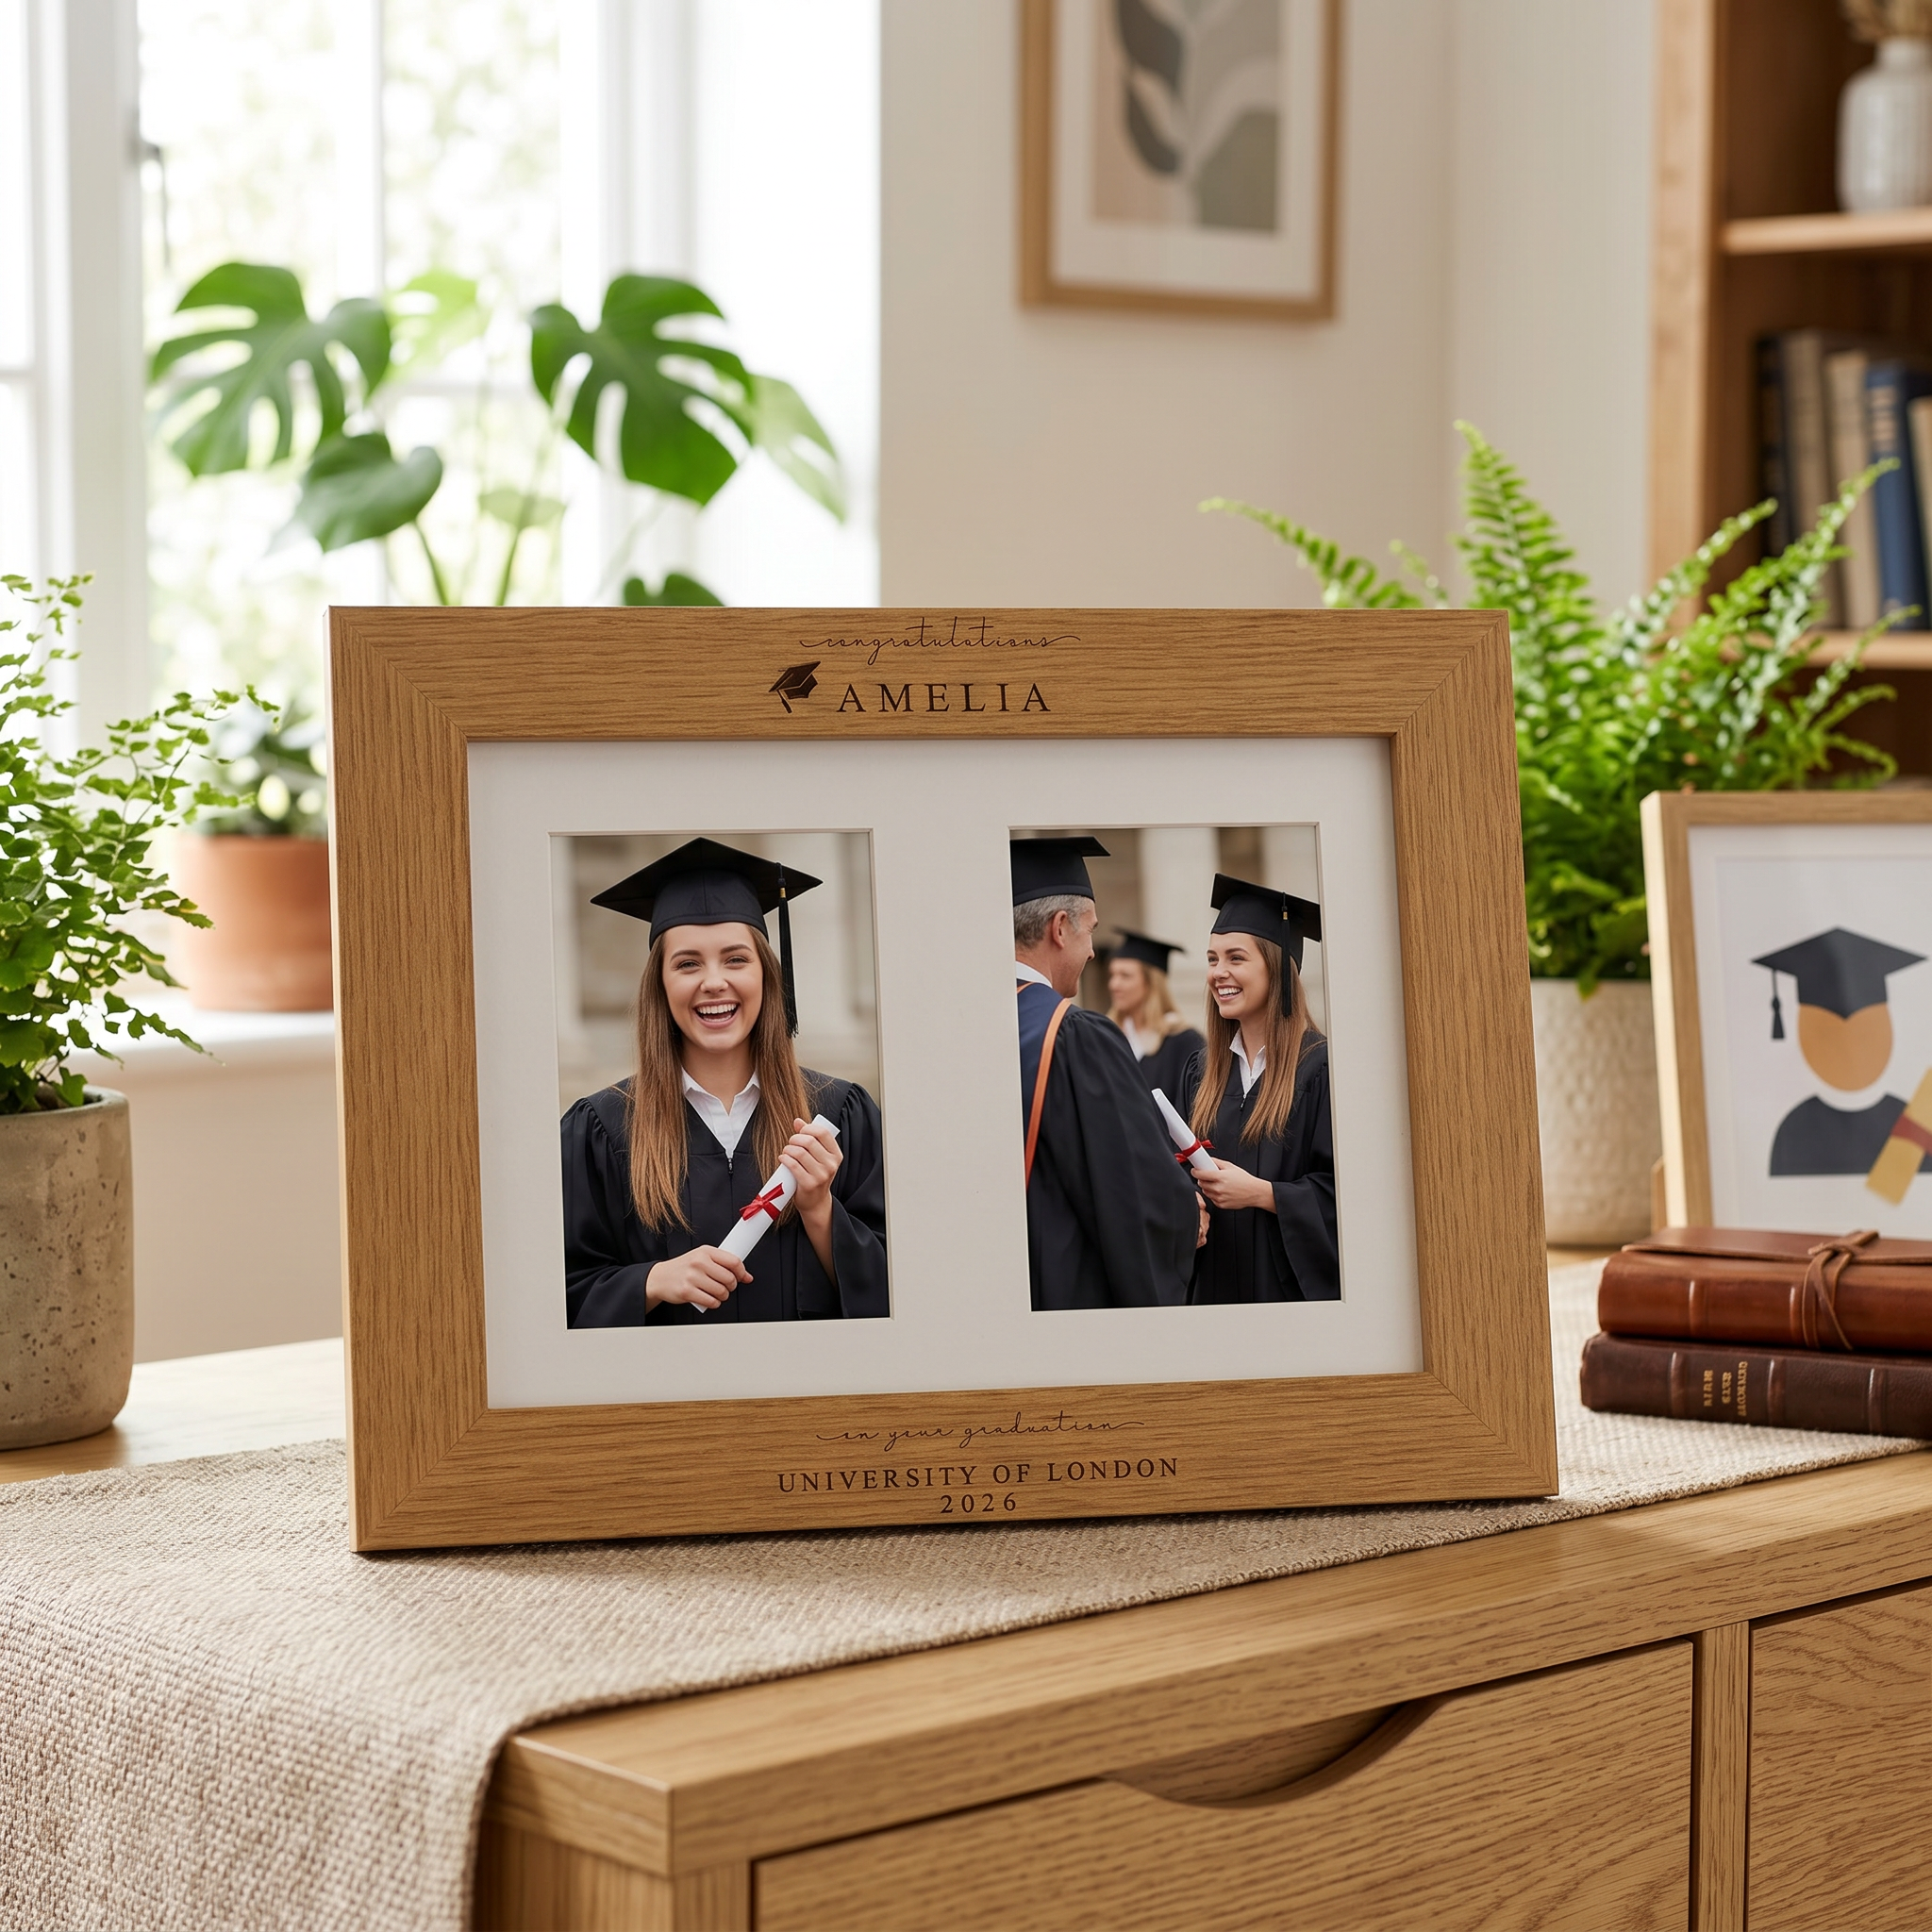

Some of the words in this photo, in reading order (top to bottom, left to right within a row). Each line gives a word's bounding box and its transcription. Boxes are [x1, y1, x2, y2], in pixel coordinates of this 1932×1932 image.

[799, 616, 1081, 665] congratulations
[836, 682, 1051, 712] AMELIA
[883, 1426, 954, 1452] your
[958, 1410, 1144, 1449] graduation
[776, 1464, 977, 1493] UNIVERSITY
[992, 1463, 1031, 1484] OF
[1047, 1457, 1178, 1482] LONDON
[940, 1491, 1017, 1514] 2026
